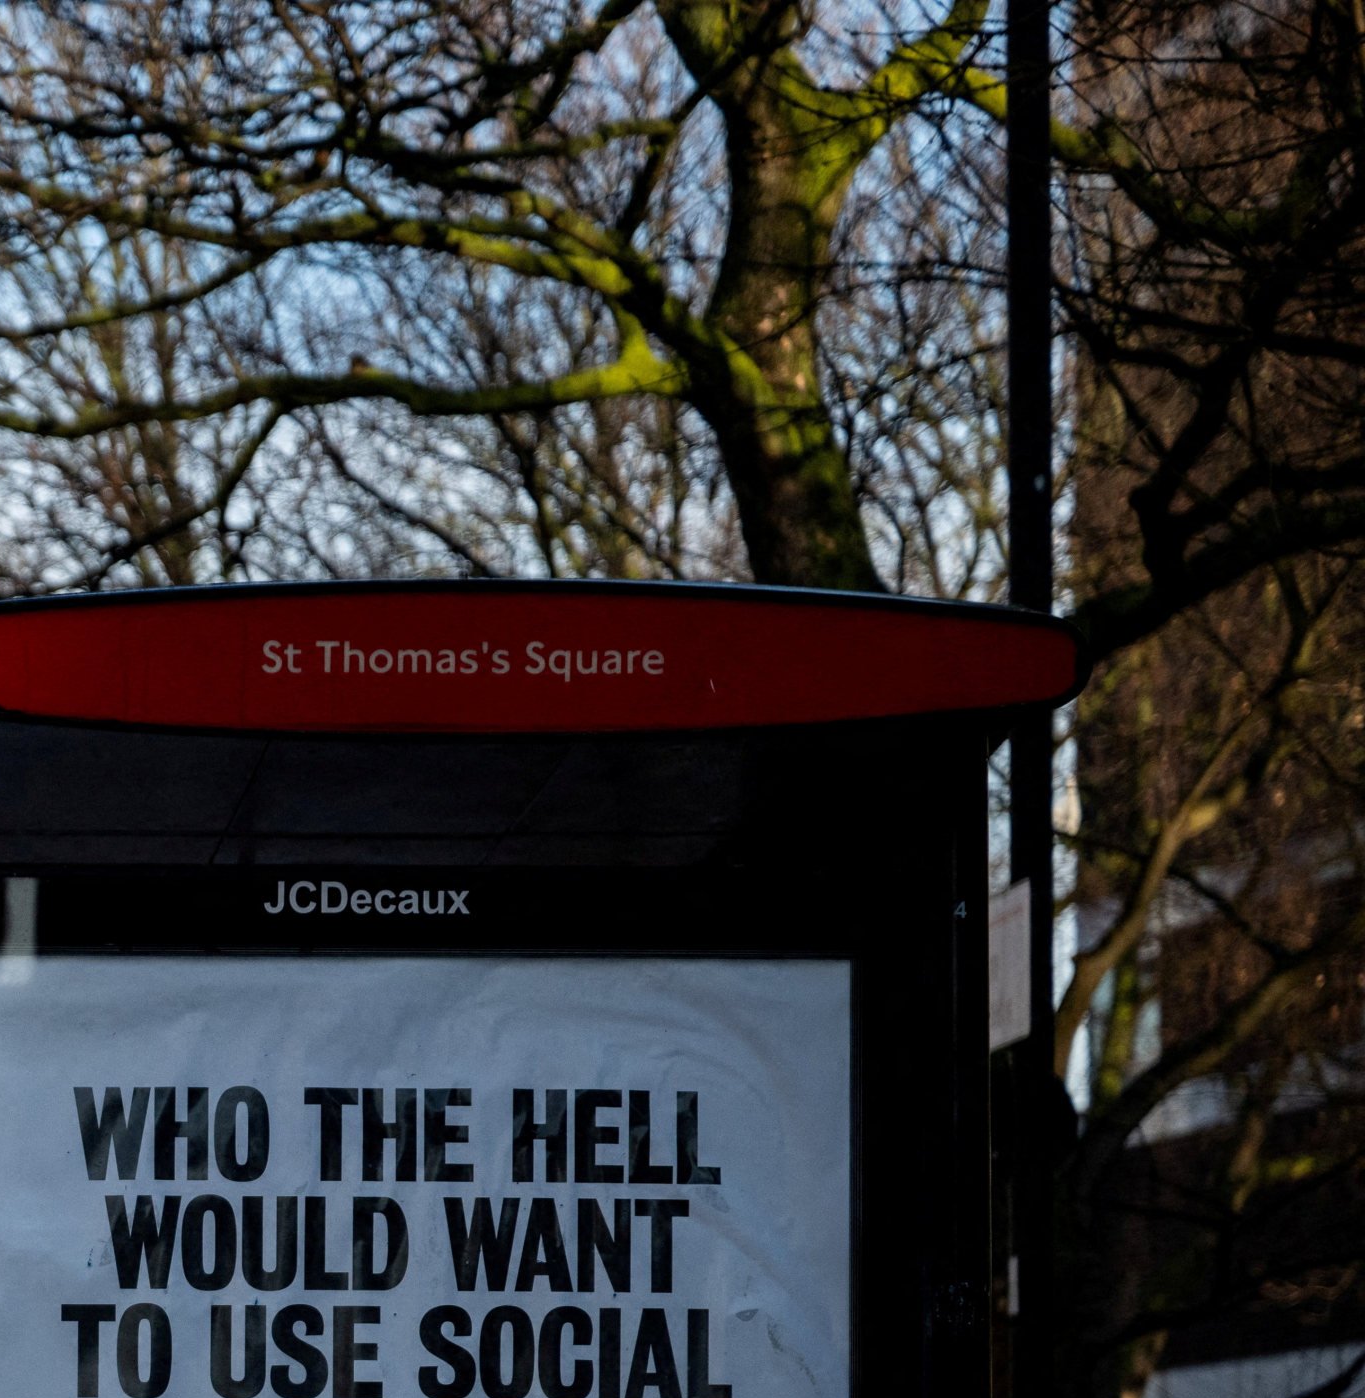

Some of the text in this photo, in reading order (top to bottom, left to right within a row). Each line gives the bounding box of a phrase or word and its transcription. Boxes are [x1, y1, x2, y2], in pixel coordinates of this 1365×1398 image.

[262, 640, 664, 682] St Thomas's Square
[264, 881, 469, 914] JCDecaux
[953, 900, 968, 919] 4
[74, 1086, 721, 1185] WHO THE HELL
[105, 1195, 689, 1293] WOULD WANT
[61, 1303, 172, 1398] TO
